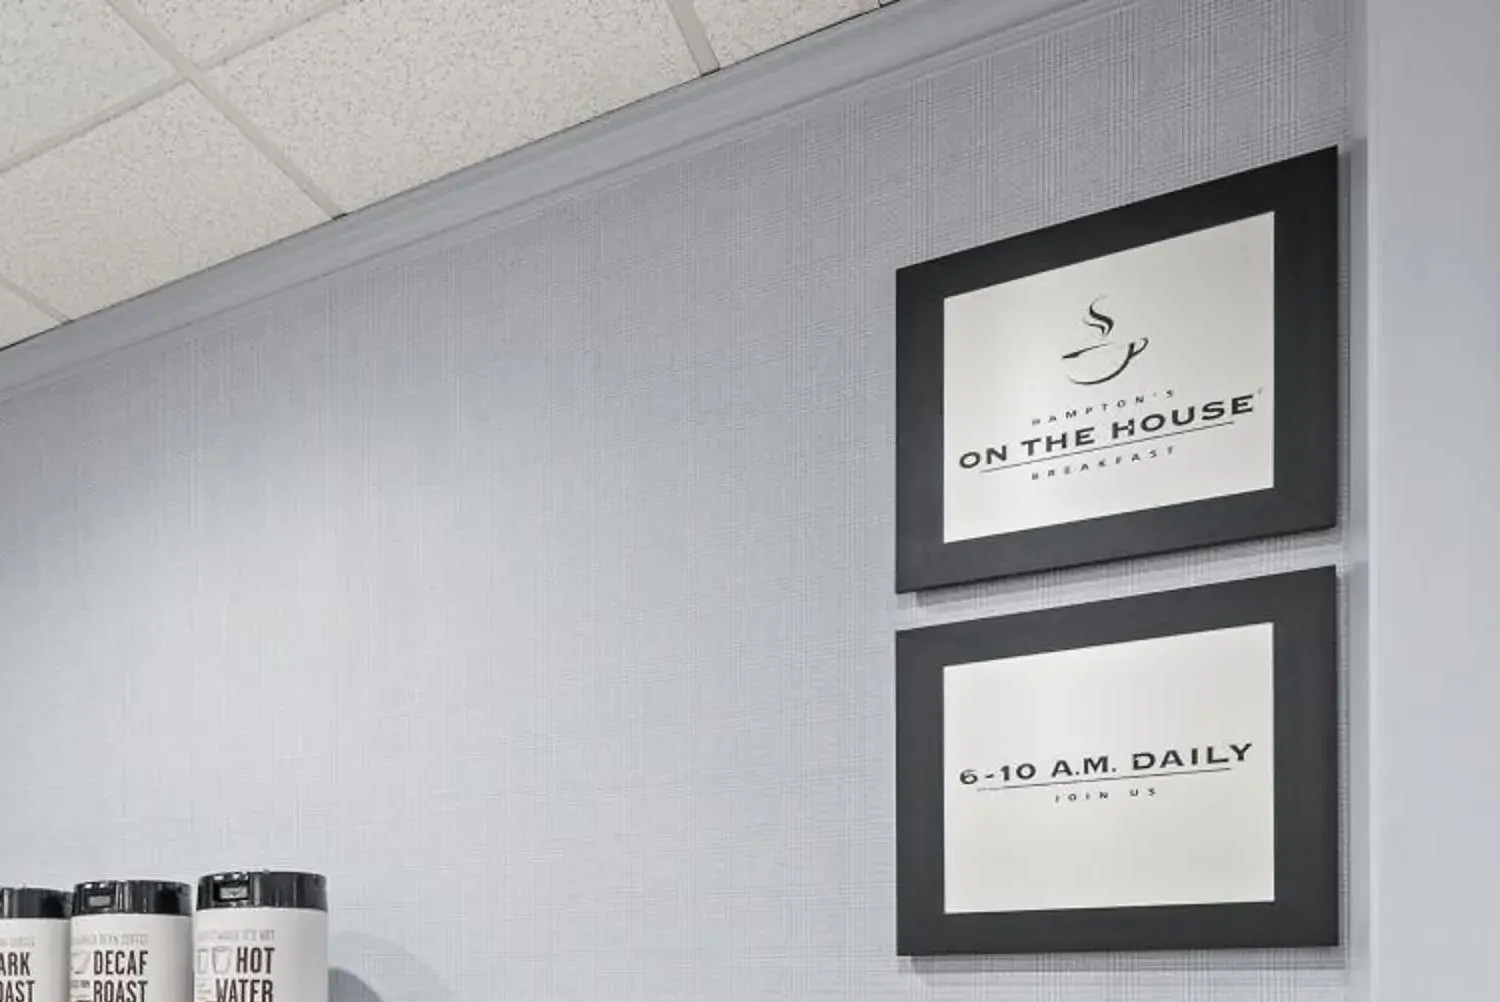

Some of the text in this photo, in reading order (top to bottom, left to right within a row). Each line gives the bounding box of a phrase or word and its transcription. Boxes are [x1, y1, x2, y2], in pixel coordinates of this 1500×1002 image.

[1031, 389, 1174, 426] HAMPTON'S
[958, 393, 1254, 470] ON THE HOUSE
[1031, 445, 1175, 481] BREAKFAST
[958, 742, 1253, 786] 6-10 A.M. DAILY
[1054, 787, 1157, 804] JOIN US
[93, 949, 149, 976] DECAF
[236, 947, 276, 975] HOT
